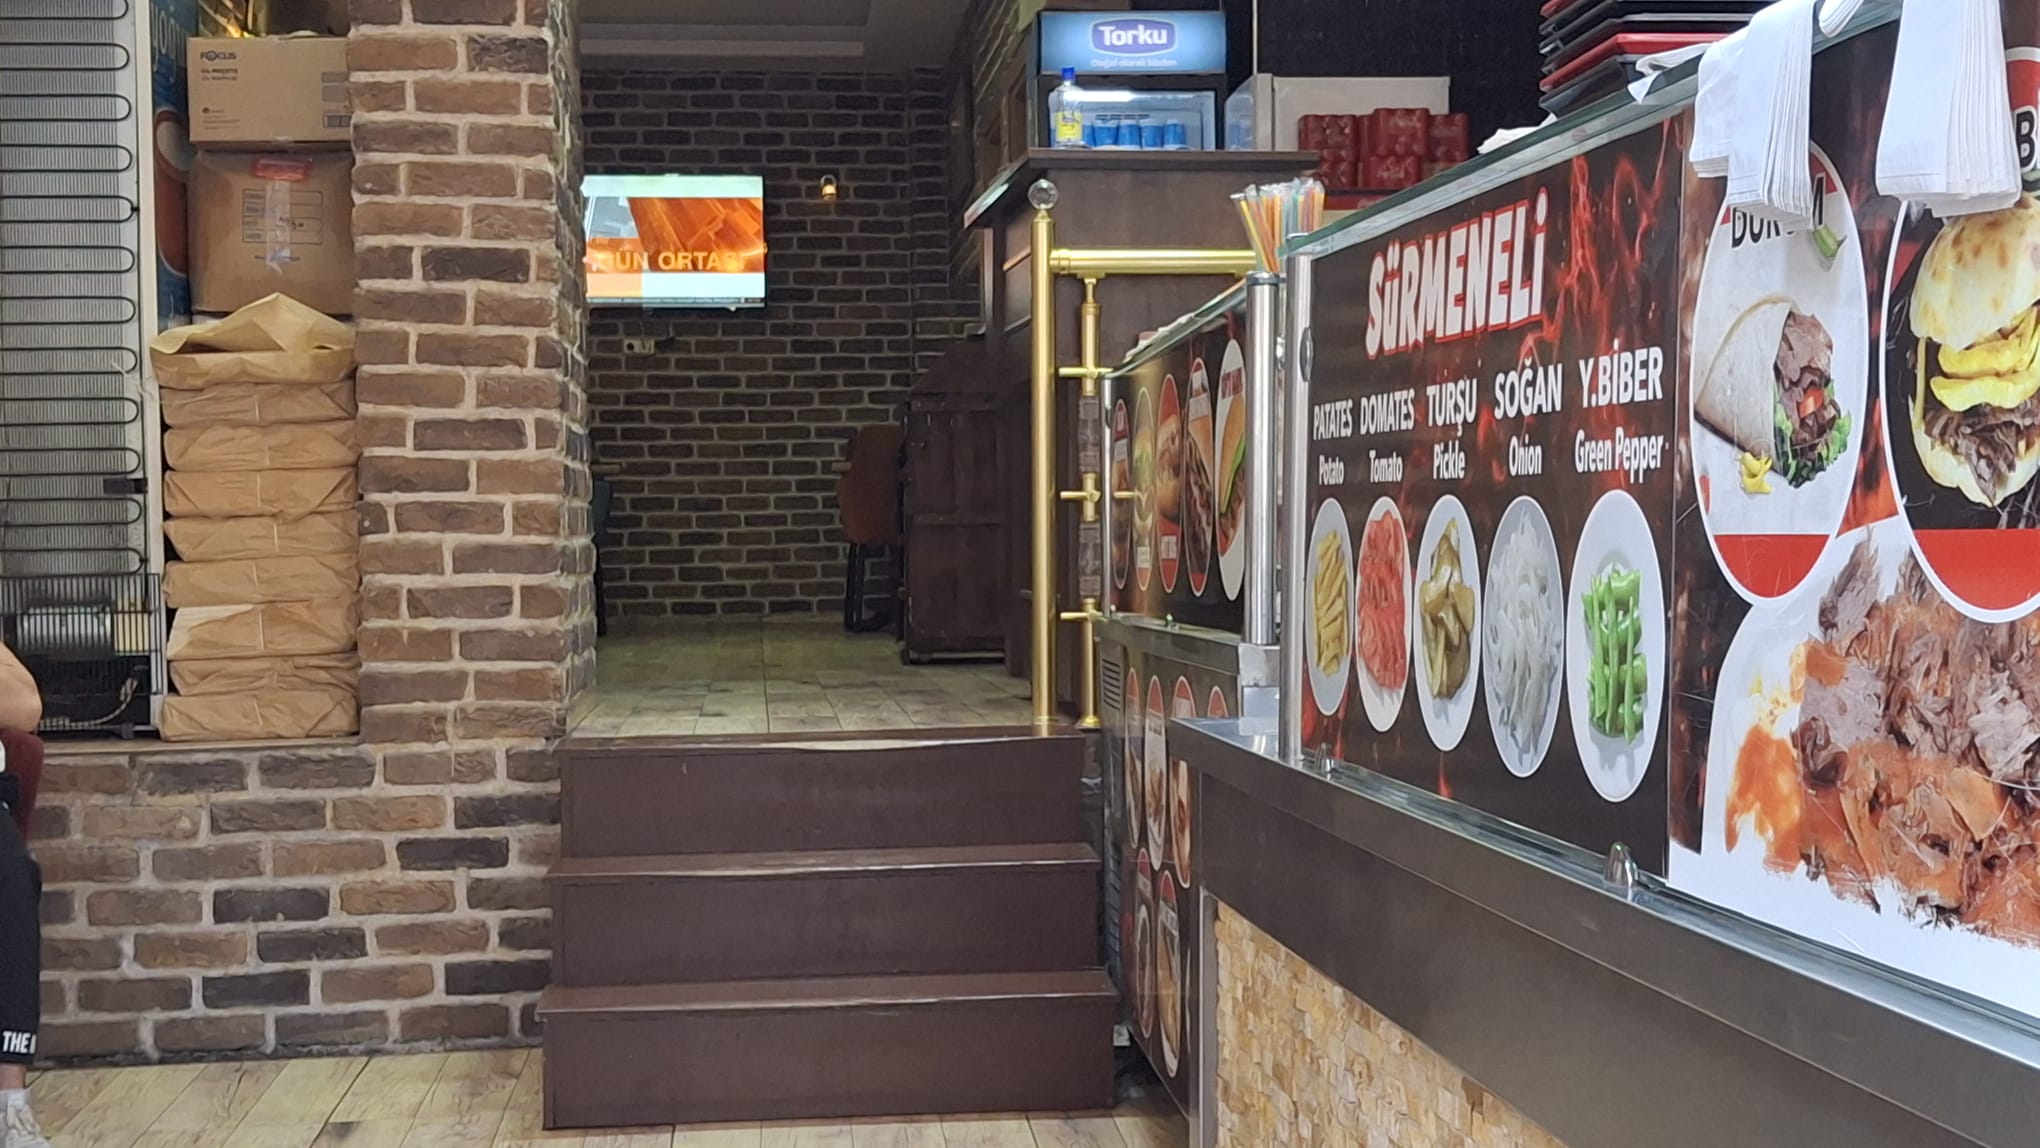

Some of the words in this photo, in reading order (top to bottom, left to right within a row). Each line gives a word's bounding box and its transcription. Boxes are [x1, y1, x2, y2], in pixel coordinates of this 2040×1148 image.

[1098, 24, 1167, 46] Torku
[200, 50, 237, 61] FOCUS
[1313, 399, 1353, 440] PATATES
[1360, 388, 1415, 435] DOMATES
[1426, 378, 1477, 437] TURŞU
[1494, 358, 1562, 420] SOĞAN
[1578, 337, 1663, 408] Y.BİBER
[1319, 455, 1344, 485] Potato
[1369, 450, 1403, 482] Tomato
[1433, 440, 1465, 480] Pickle
[1509, 433, 1542, 477] Onion
[1575, 429, 1612, 473] Green
[1615, 426, 1664, 484] Pepper
[2, 1030, 31, 1054] THE
